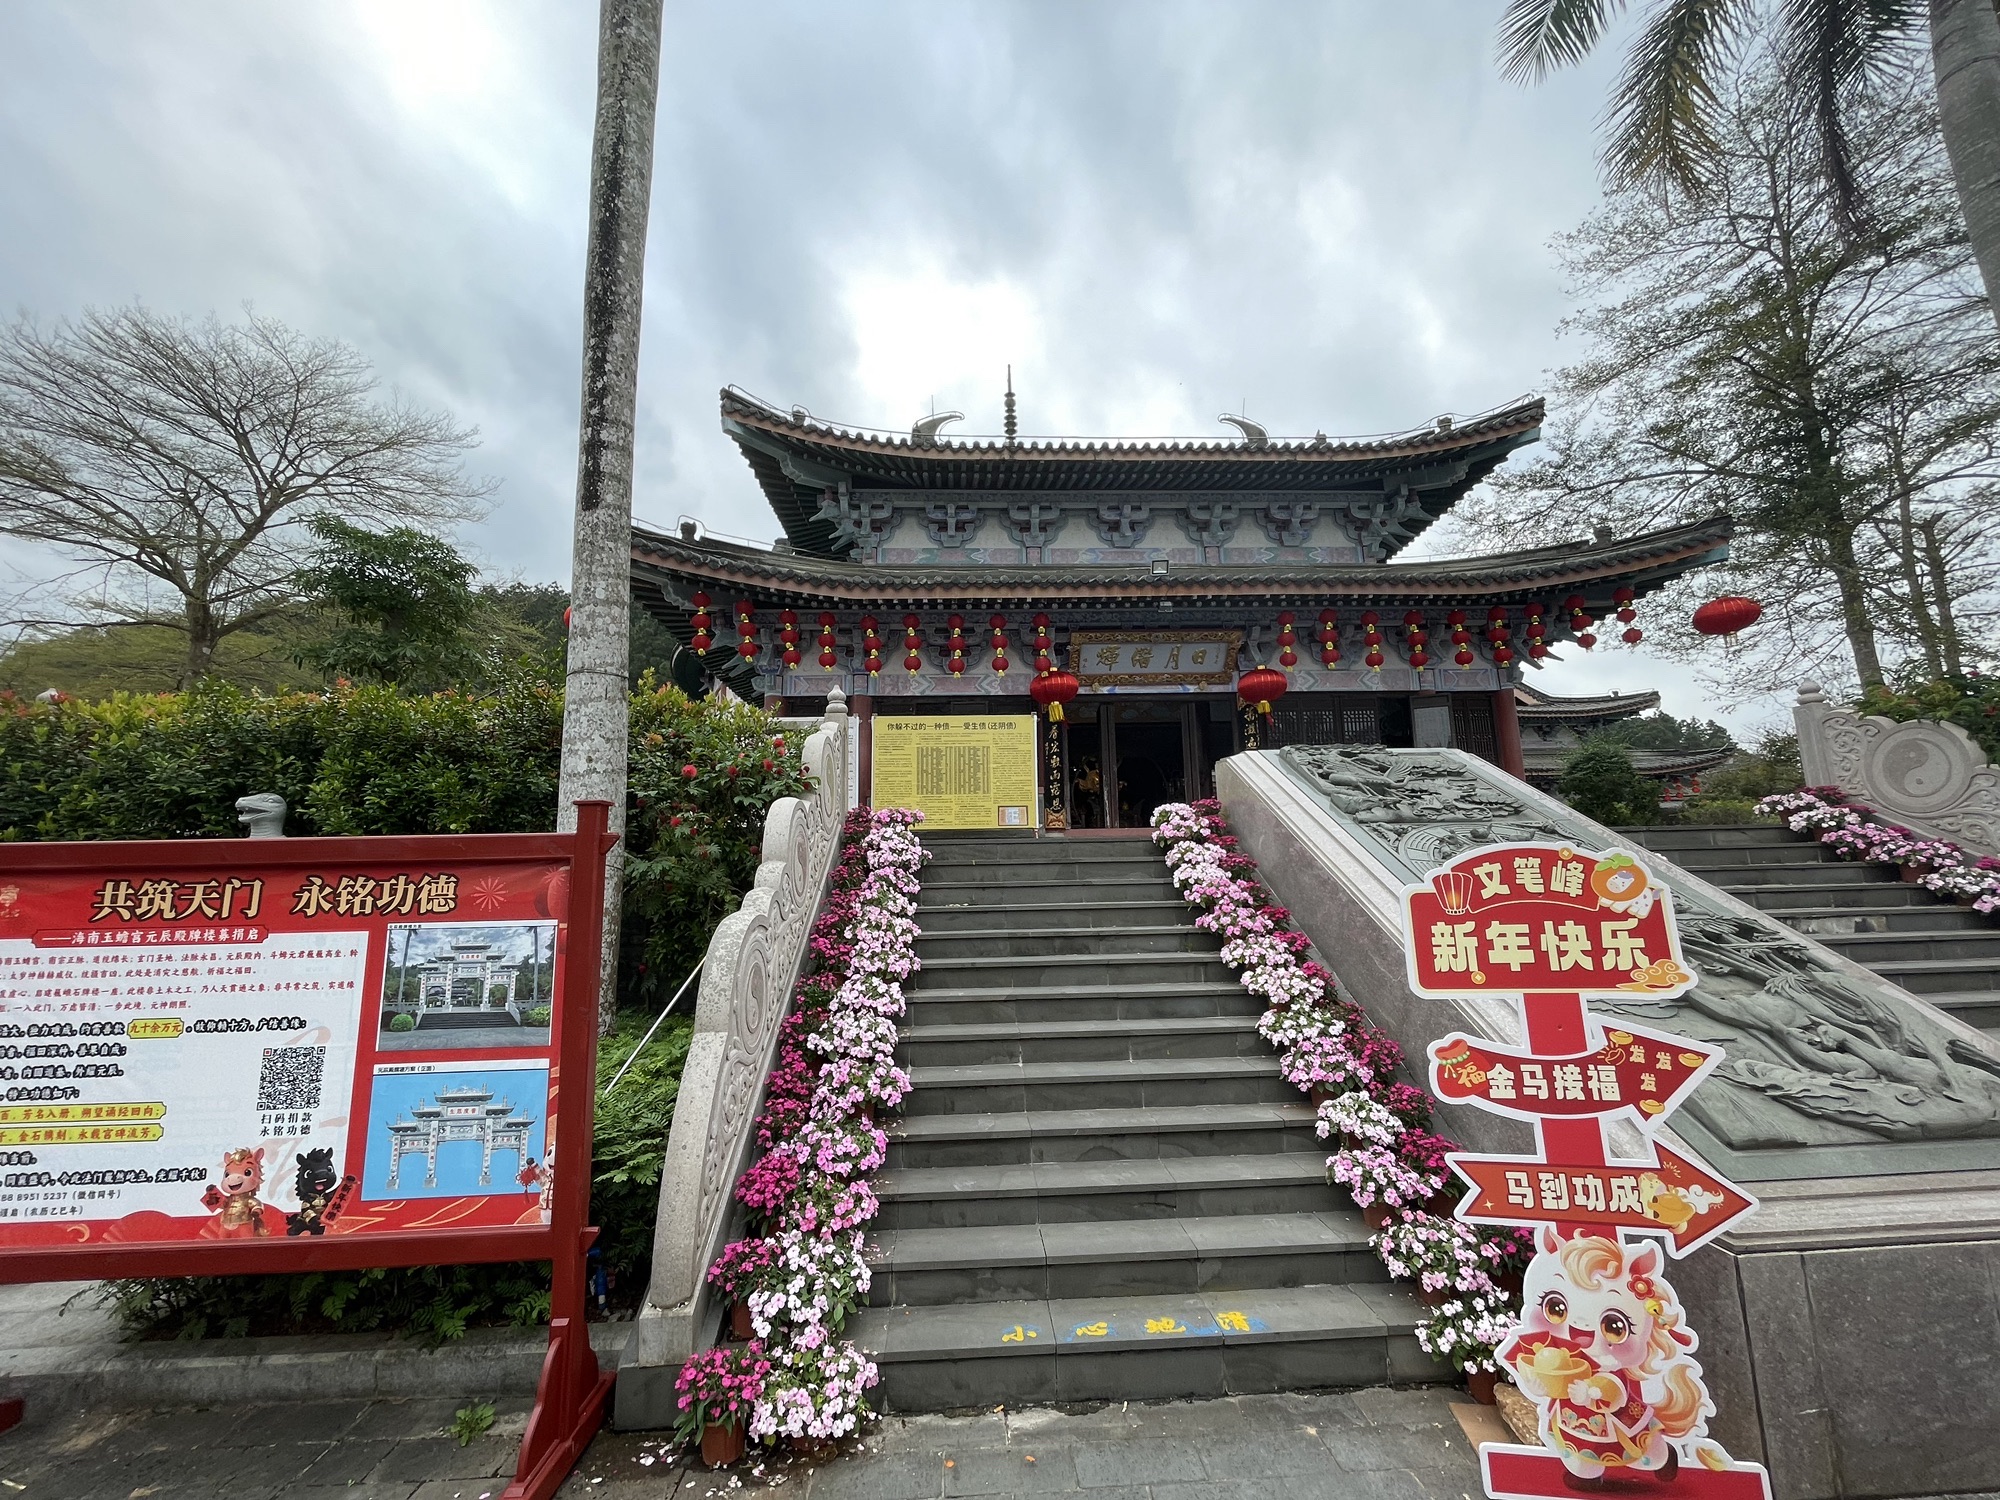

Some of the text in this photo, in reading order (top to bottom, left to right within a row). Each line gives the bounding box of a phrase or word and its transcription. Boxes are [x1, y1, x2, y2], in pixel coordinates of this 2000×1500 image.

[1473, 856, 1586, 899] 文笔峰
[91, 874, 458, 922] 共筑天门 永铭功德
[1431, 920, 1650, 974] 新年快乐
[1630, 1045, 1645, 1064] 发
[1656, 1052, 1672, 1070] 发
[1458, 1061, 1487, 1088] 福
[1486, 1063, 1620, 1101] 金马接福
[1640, 1072, 1656, 1091] 发
[259, 1125, 311, 1137] 永铭功德
[261, 1112, 312, 1124] 扫码捐款
[1504, 1170, 1644, 1215] 马到功成
